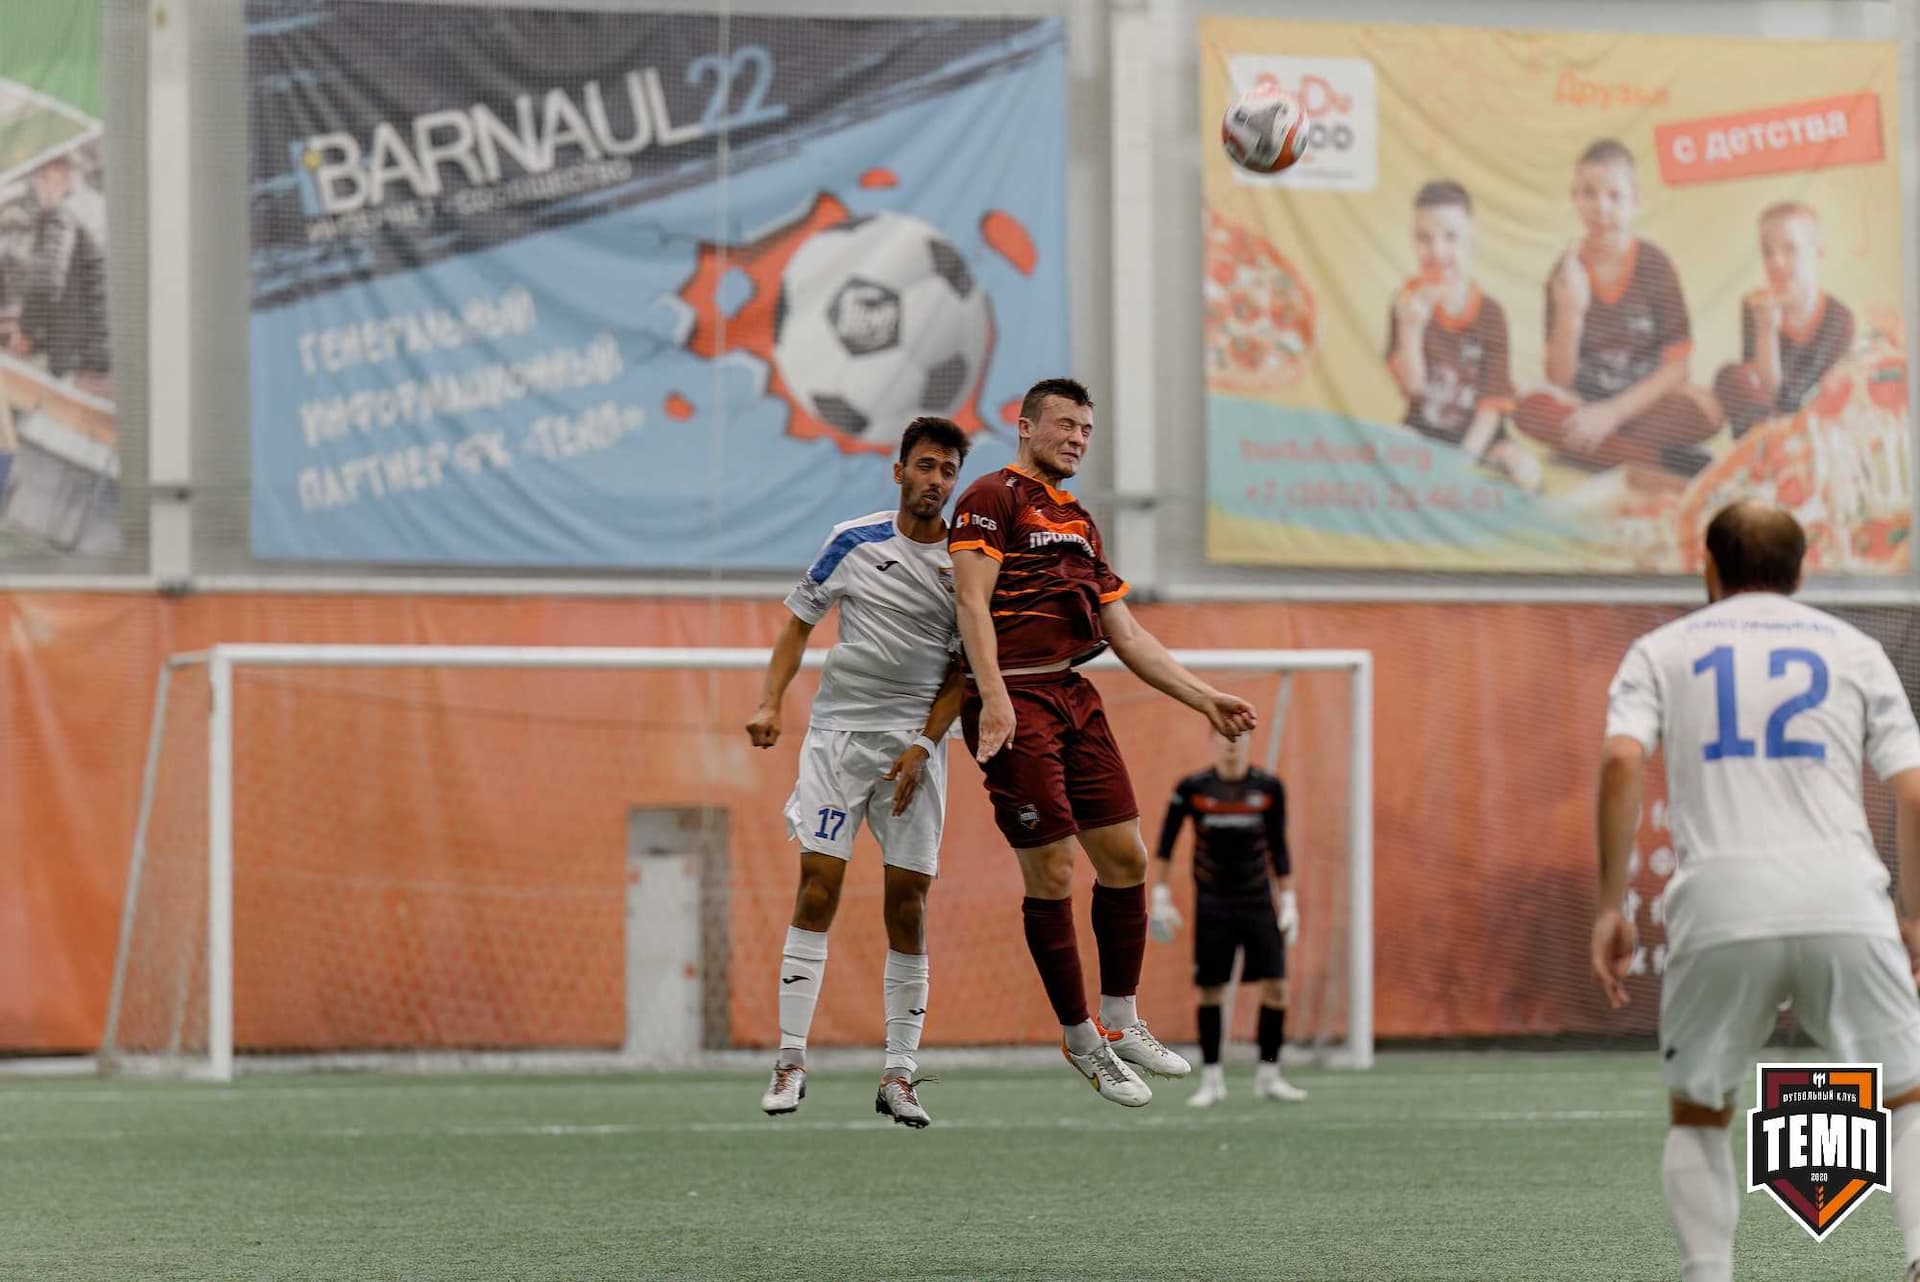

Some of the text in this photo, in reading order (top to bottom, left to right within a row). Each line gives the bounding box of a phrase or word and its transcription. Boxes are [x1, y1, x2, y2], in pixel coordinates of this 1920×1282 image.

[1704, 110, 1848, 165] детства
[971, 513, 998, 531] ПСБ
[1692, 644, 1830, 761] 12
[813, 807, 847, 841] 17
